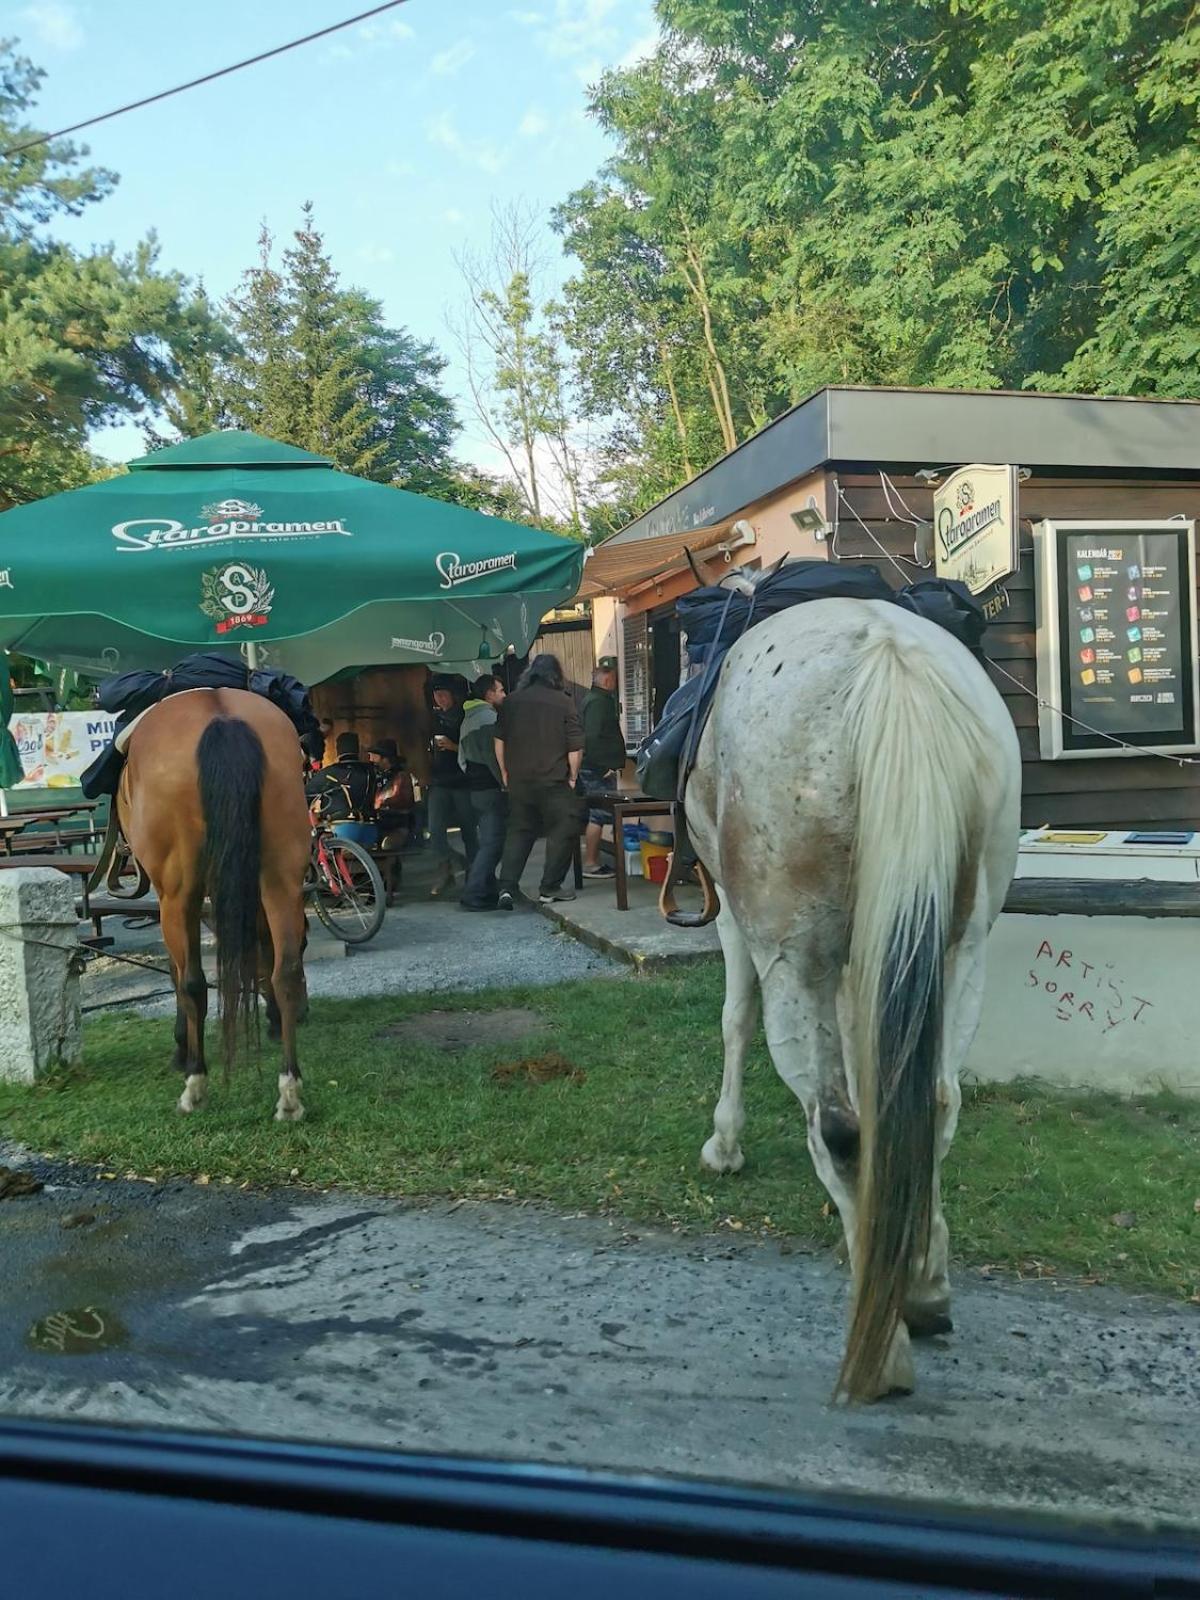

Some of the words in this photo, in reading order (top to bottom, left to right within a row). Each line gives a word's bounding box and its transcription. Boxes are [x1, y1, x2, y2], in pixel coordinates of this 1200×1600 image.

[111, 517, 352, 551] Staropramen
[938, 498, 1005, 563] Staropramen
[220, 565, 258, 614] S
[436, 551, 518, 589] Staropramen
[230, 614, 253, 625] 1869
[1024, 969, 1126, 1034] SORRY
